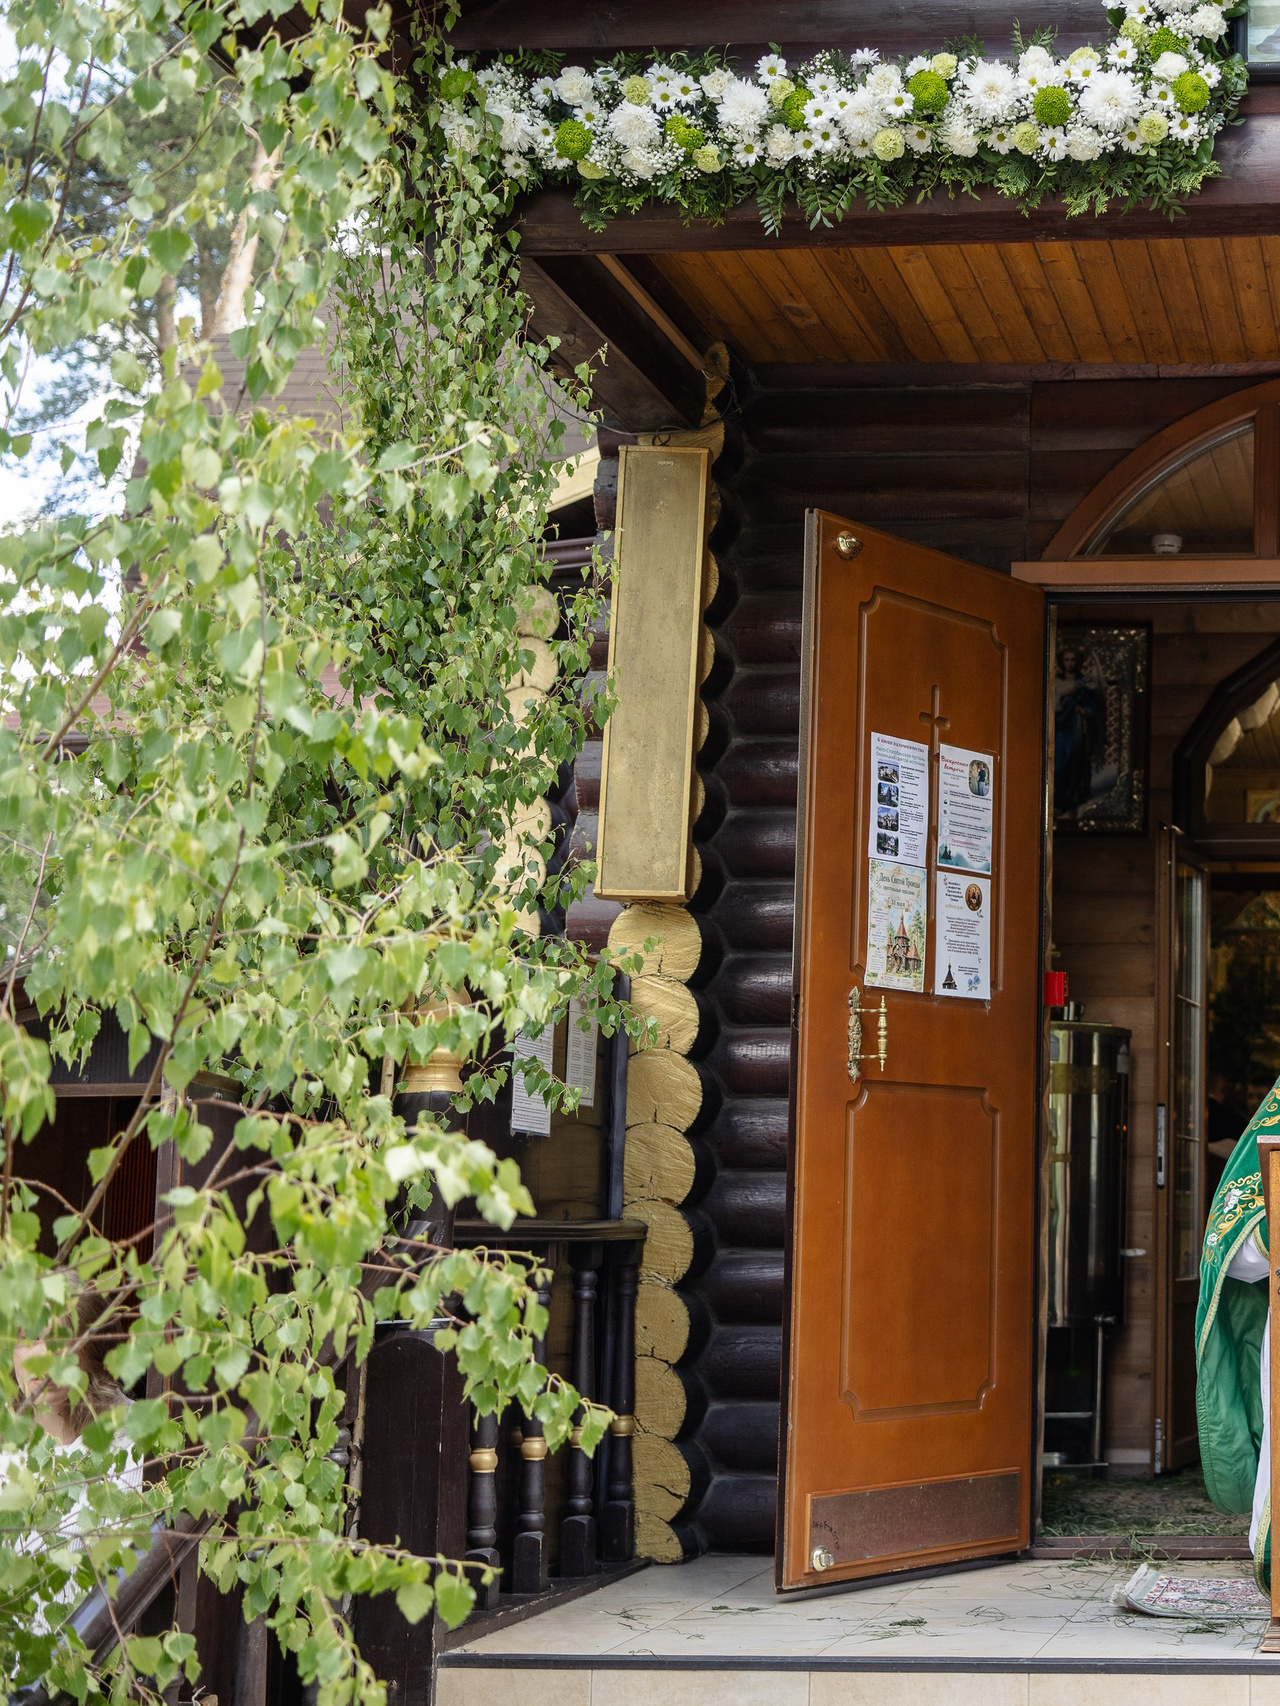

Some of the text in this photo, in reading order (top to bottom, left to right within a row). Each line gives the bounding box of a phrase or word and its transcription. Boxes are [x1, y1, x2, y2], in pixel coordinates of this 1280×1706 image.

[879, 872, 920, 888] День Святой Троицы
